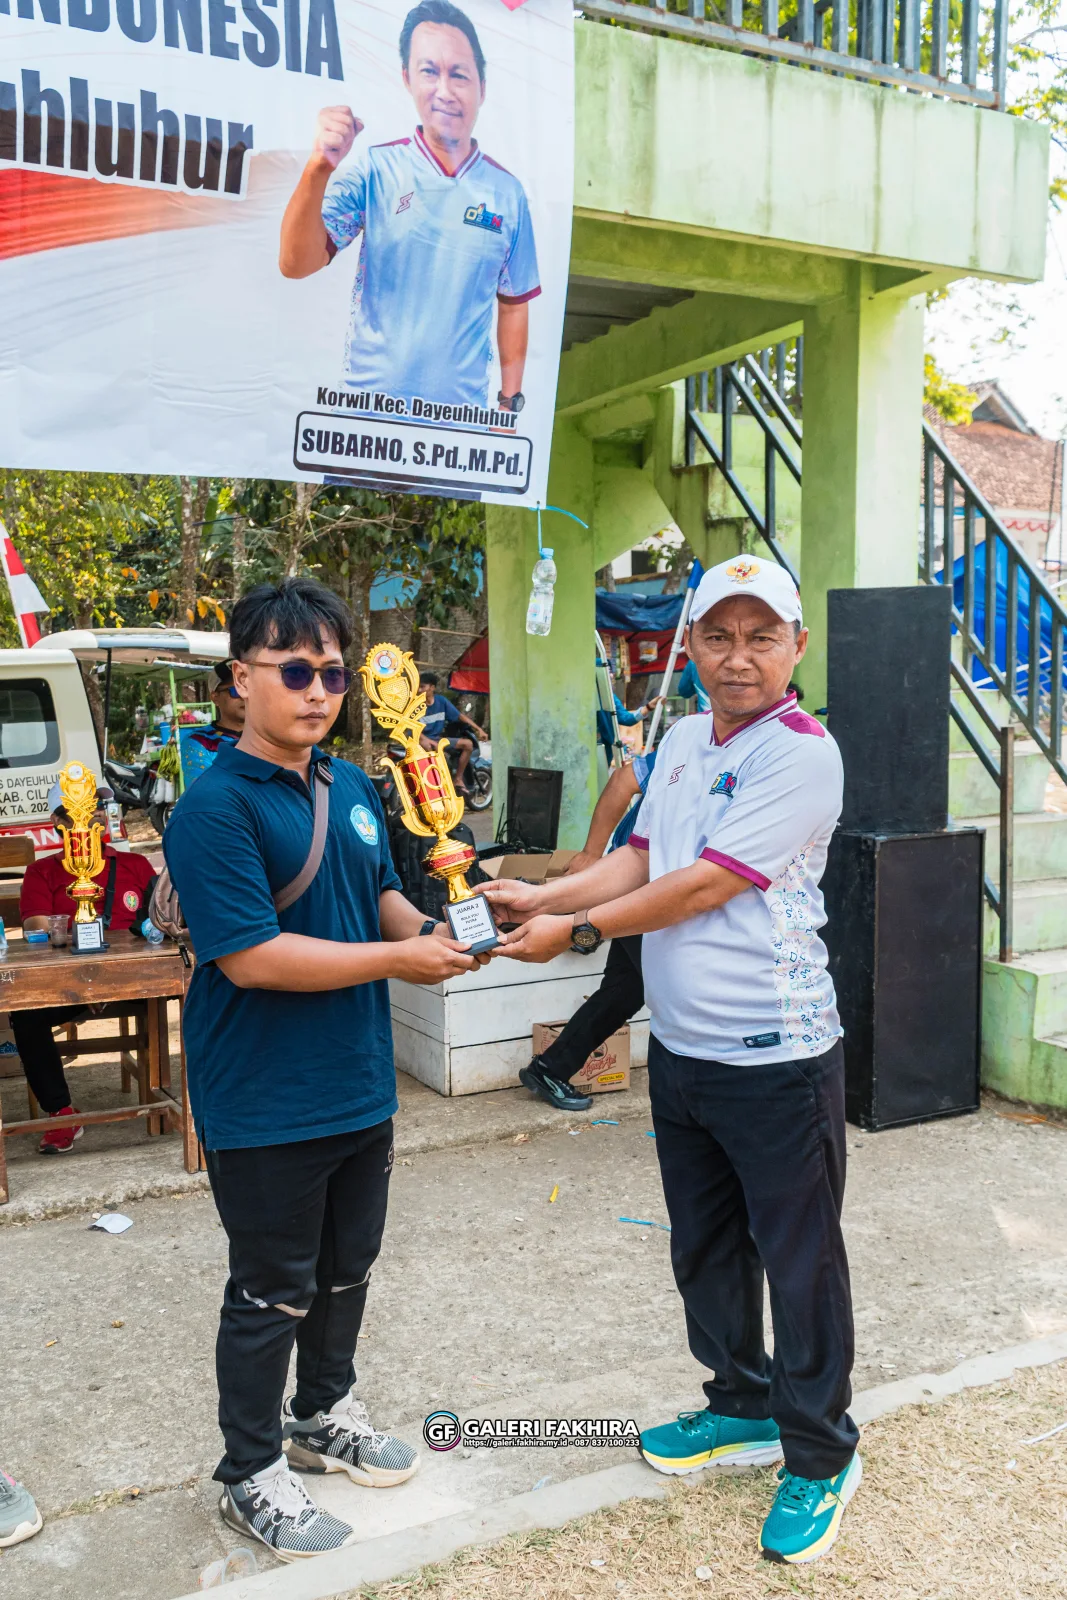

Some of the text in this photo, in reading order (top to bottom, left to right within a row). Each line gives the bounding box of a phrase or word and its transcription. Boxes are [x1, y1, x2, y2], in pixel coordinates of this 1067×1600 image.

[0, 0, 344, 81] NESIA
[317, 387, 518, 428] Korwil Kec. Dayeuhluhur
[301, 428, 524, 476] SUBARNO, S.Pd.,M.Pd.
[10, 804, 28, 815] TA.
